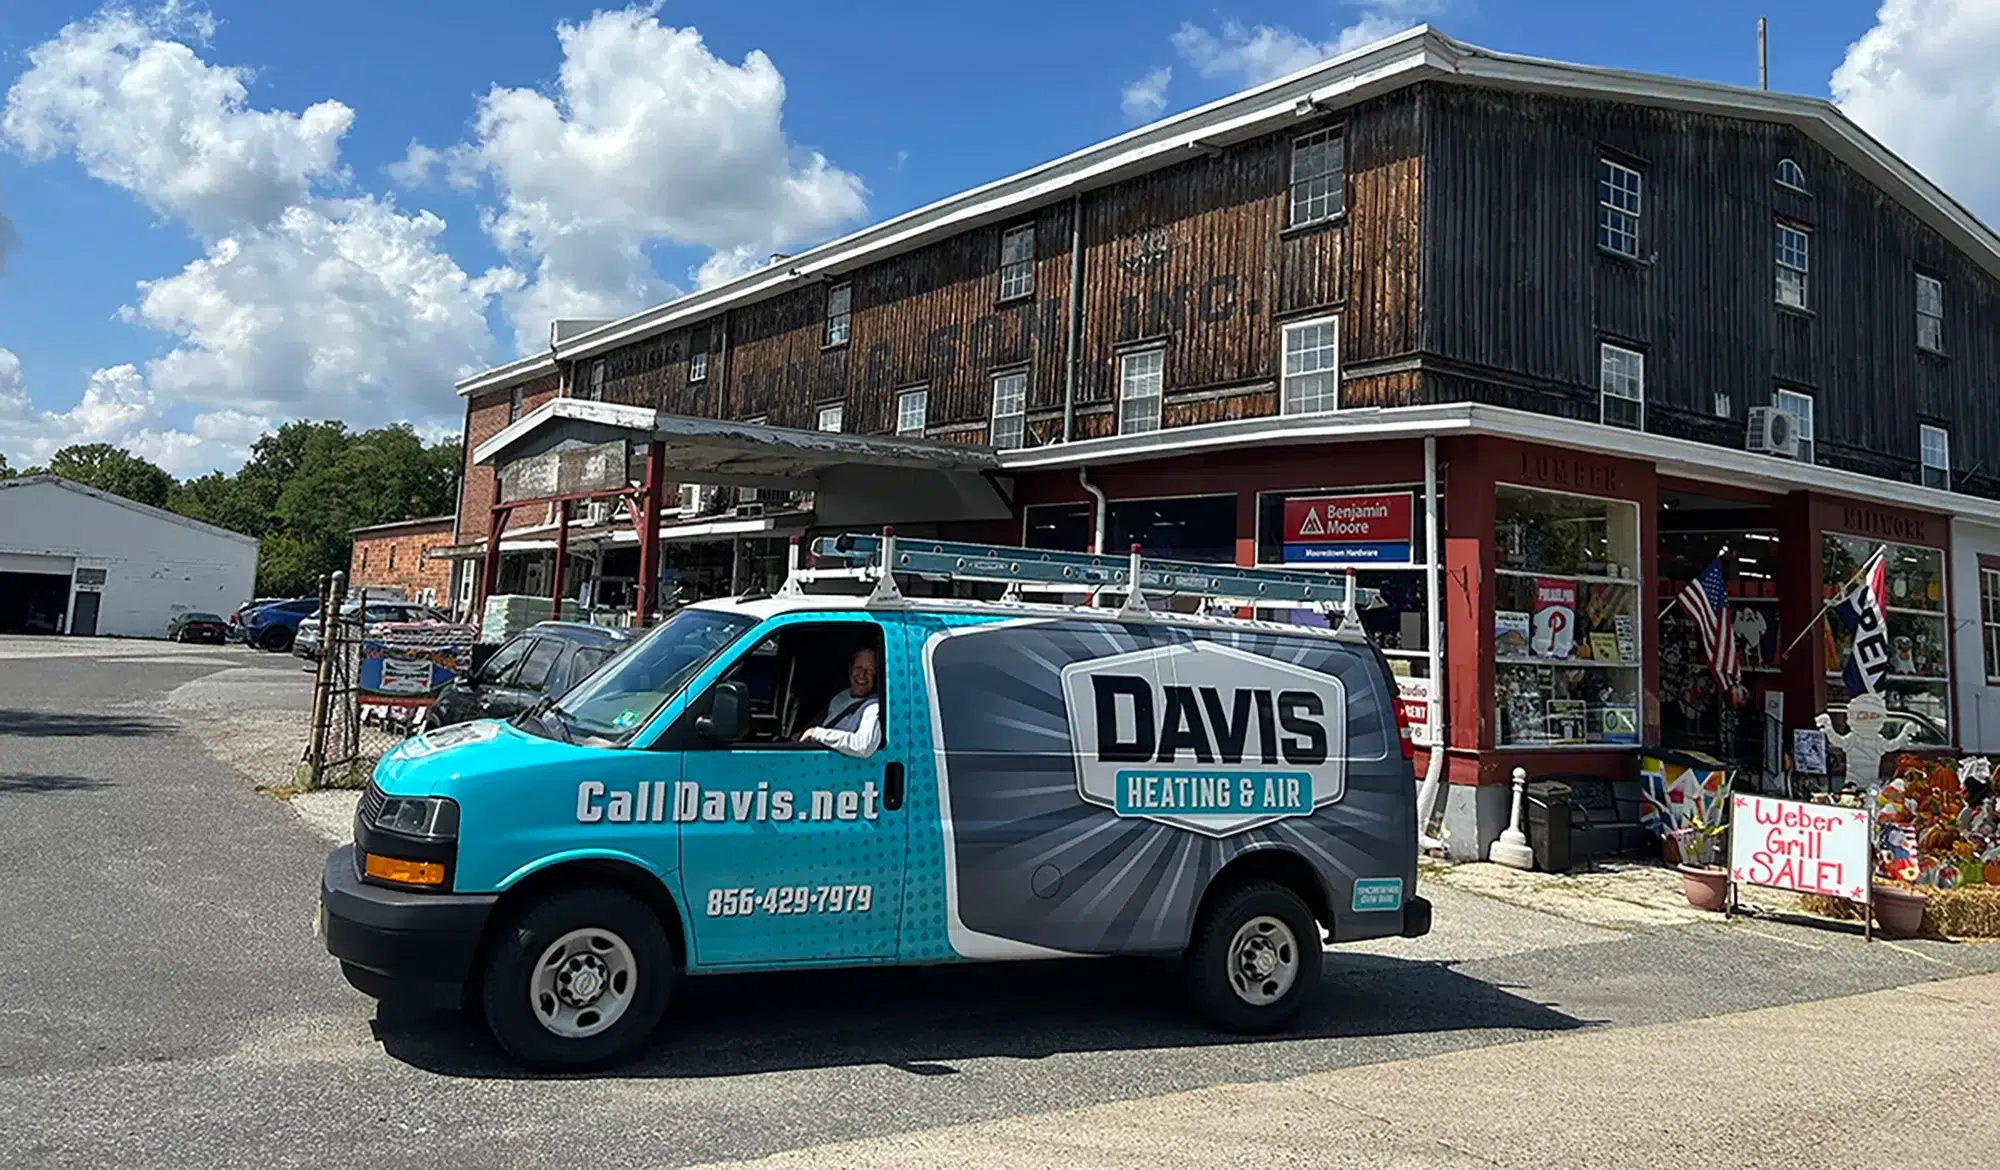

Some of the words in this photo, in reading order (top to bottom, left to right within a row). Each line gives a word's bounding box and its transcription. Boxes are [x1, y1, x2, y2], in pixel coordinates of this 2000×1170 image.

[1120, 274, 1262, 343] INC.
[1521, 452, 1616, 491] LUMBER
[1327, 502, 1389, 522] Benjamin
[1327, 521, 1369, 534] Moore
[1843, 507, 1925, 541] MILLWORK
[1305, 549, 1344, 557] Moorestown
[1346, 548, 1378, 557] Hardware
[1091, 674, 1328, 765] DAVIS
[577, 780, 879, 824] CallDavis.net
[1126, 777, 1231, 809] HEATING
[1239, 779, 1255, 807] &
[1262, 778, 1302, 808] AIR
[1755, 799, 1842, 832] Weber
[1766, 827, 1821, 859] Grill
[1749, 851, 1842, 895] SALE!
